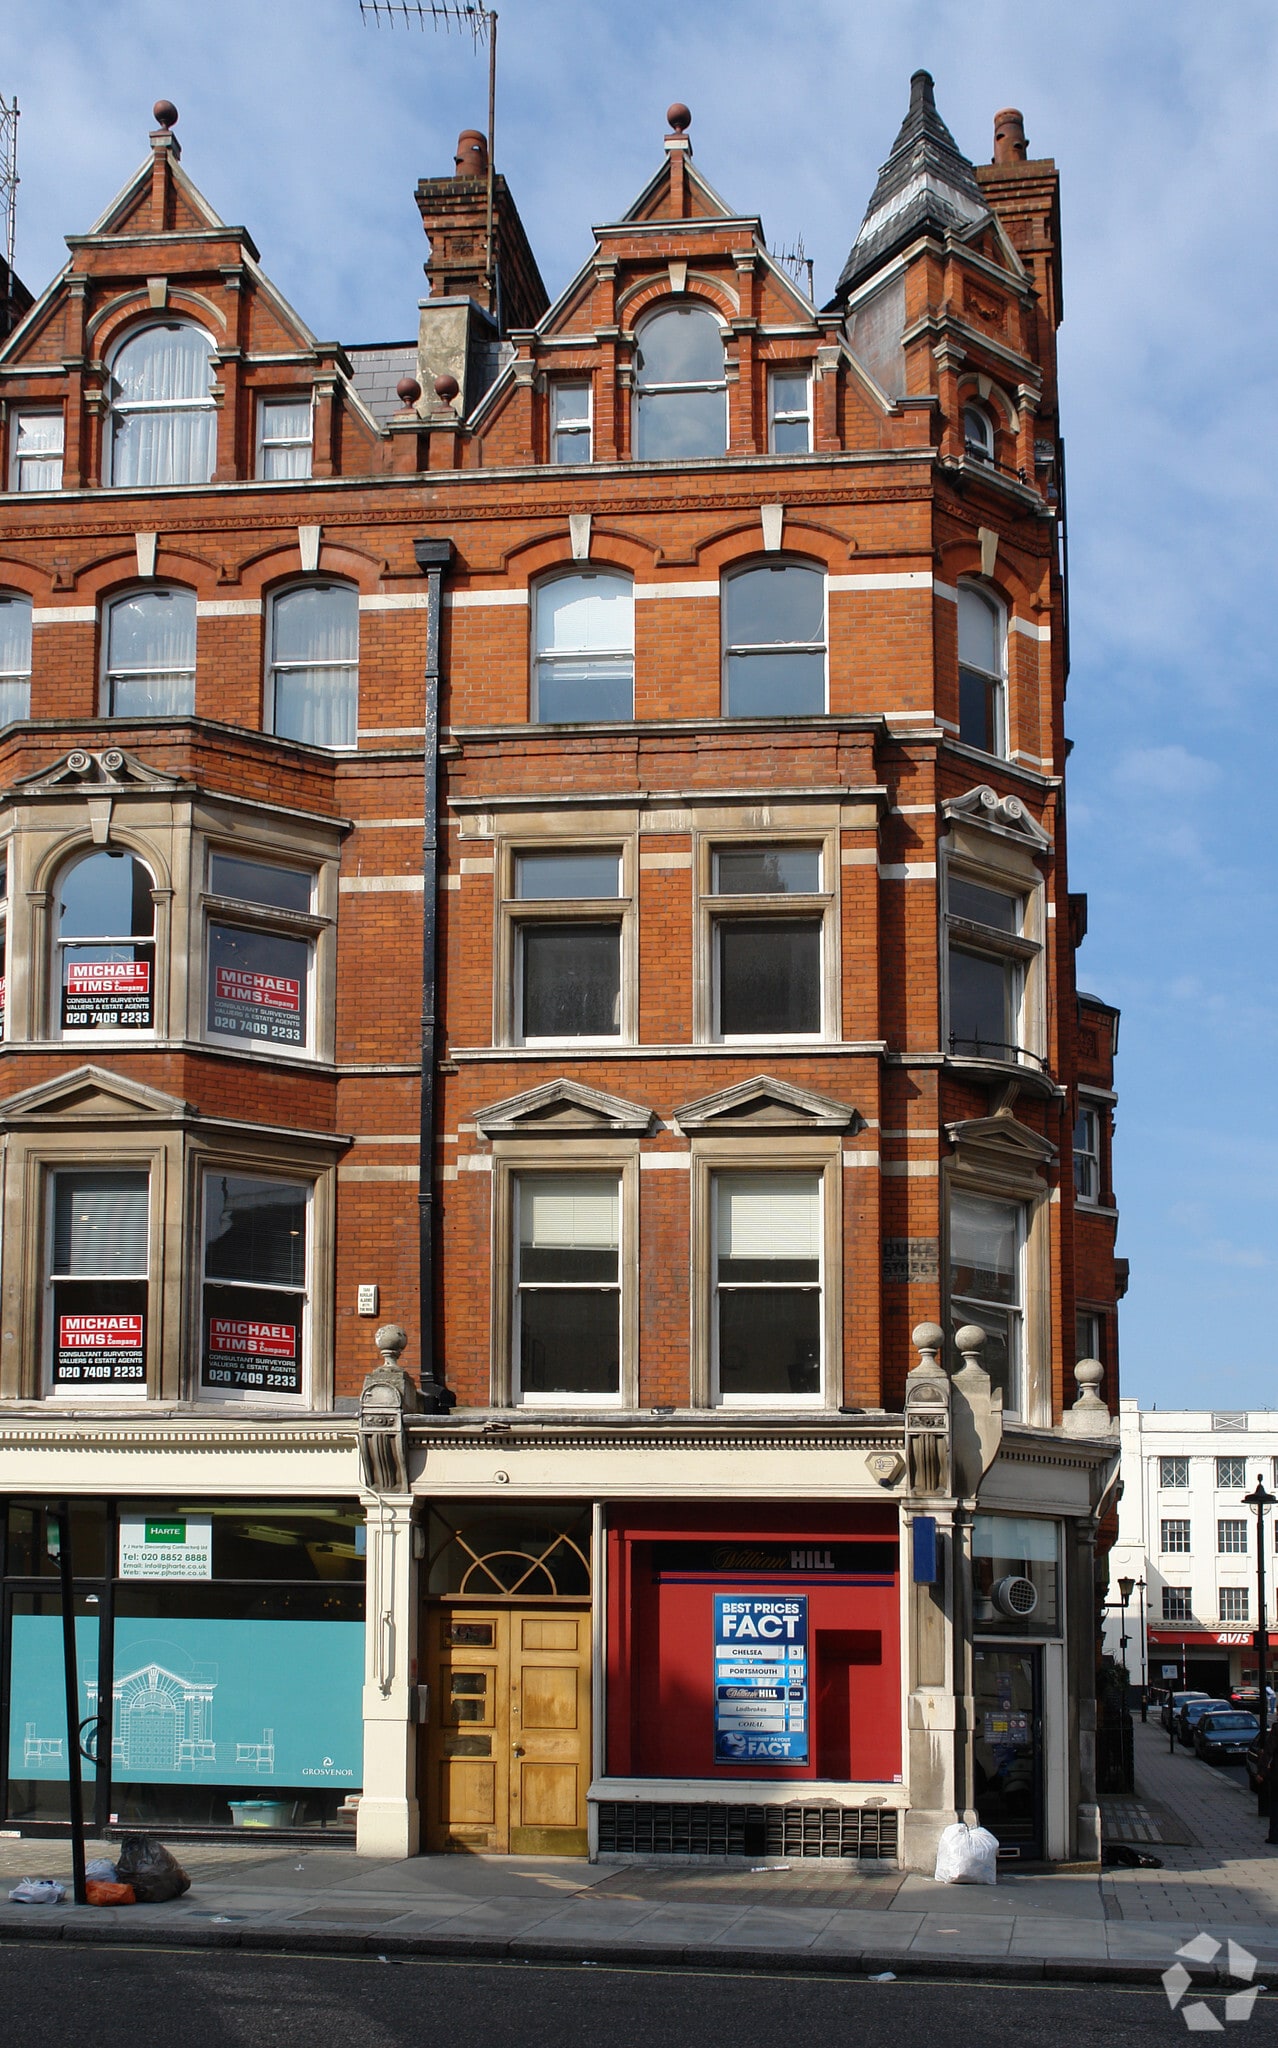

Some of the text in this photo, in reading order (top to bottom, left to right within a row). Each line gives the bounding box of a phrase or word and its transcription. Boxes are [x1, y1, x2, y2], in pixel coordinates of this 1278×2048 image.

[73, 964, 145, 976] MICHAEL
[73, 980, 112, 992] TIMS
[221, 970, 294, 993] MICHAEL
[221, 985, 262, 1002] TIMS
[264, 997, 294, 1008] Company
[214, 1001, 300, 1021] CONSULTANT SURVEYORS
[66, 1012, 149, 1024] 020 7409 2233
[215, 1008, 243, 1017] VALUERS
[251, 1014, 274, 1023] ESTATE
[275, 1017, 300, 1027] AGENTS
[214, 1016, 300, 1040] 020 7409 2233
[883, 1244, 937, 1257] DUKE
[883, 1262, 937, 1273] STREET
[65, 1318, 138, 1329] MICHAEL
[216, 1321, 290, 1339] MICHAEL
[65, 1333, 105, 1345] TIMS
[216, 1337, 257, 1351] TIMS
[209, 1354, 296, 1367] CONSULTANT SURVEYORS
[59, 1366, 143, 1378] 020 7409 2233
[209, 1370, 296, 1387] 020 7409 2233
[150, 1527, 181, 1535] HARTE
[123, 1553, 139, 1561] Tel:
[141, 1553, 158, 1561] 020
[160, 1553, 183, 1561] 8852
[791, 1551, 835, 1569] HILL
[722, 1603, 799, 1614] BEST PRICES
[1217, 1633, 1251, 1644] AVIS
[759, 1689, 777, 1698] HILL
[748, 1742, 791, 1755] FACT
[302, 1767, 354, 1776] GROSVENOR
